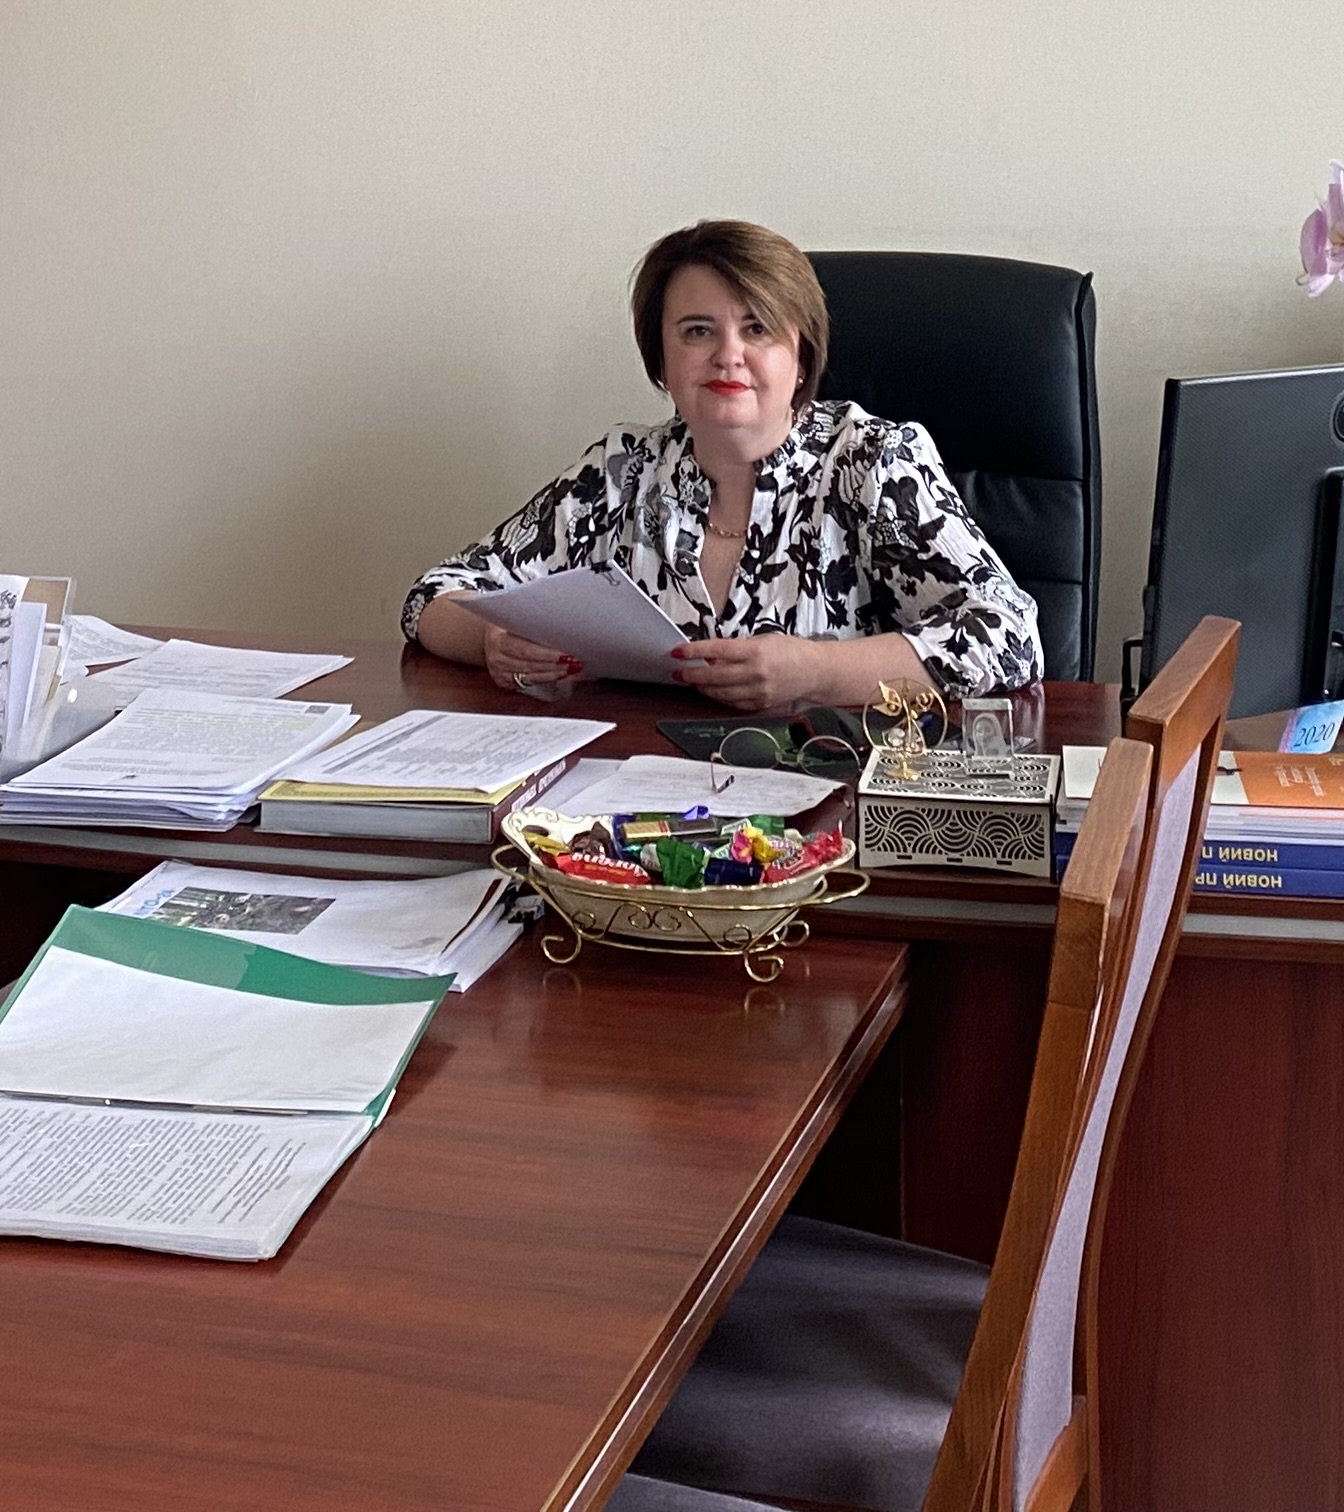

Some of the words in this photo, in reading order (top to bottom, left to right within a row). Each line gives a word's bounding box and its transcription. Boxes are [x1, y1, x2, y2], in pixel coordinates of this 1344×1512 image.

[1293, 722, 1336, 747] 2020
[1218, 846, 1278, 862] НОВИЙ
[1222, 874, 1282, 888] НОВИЙ
